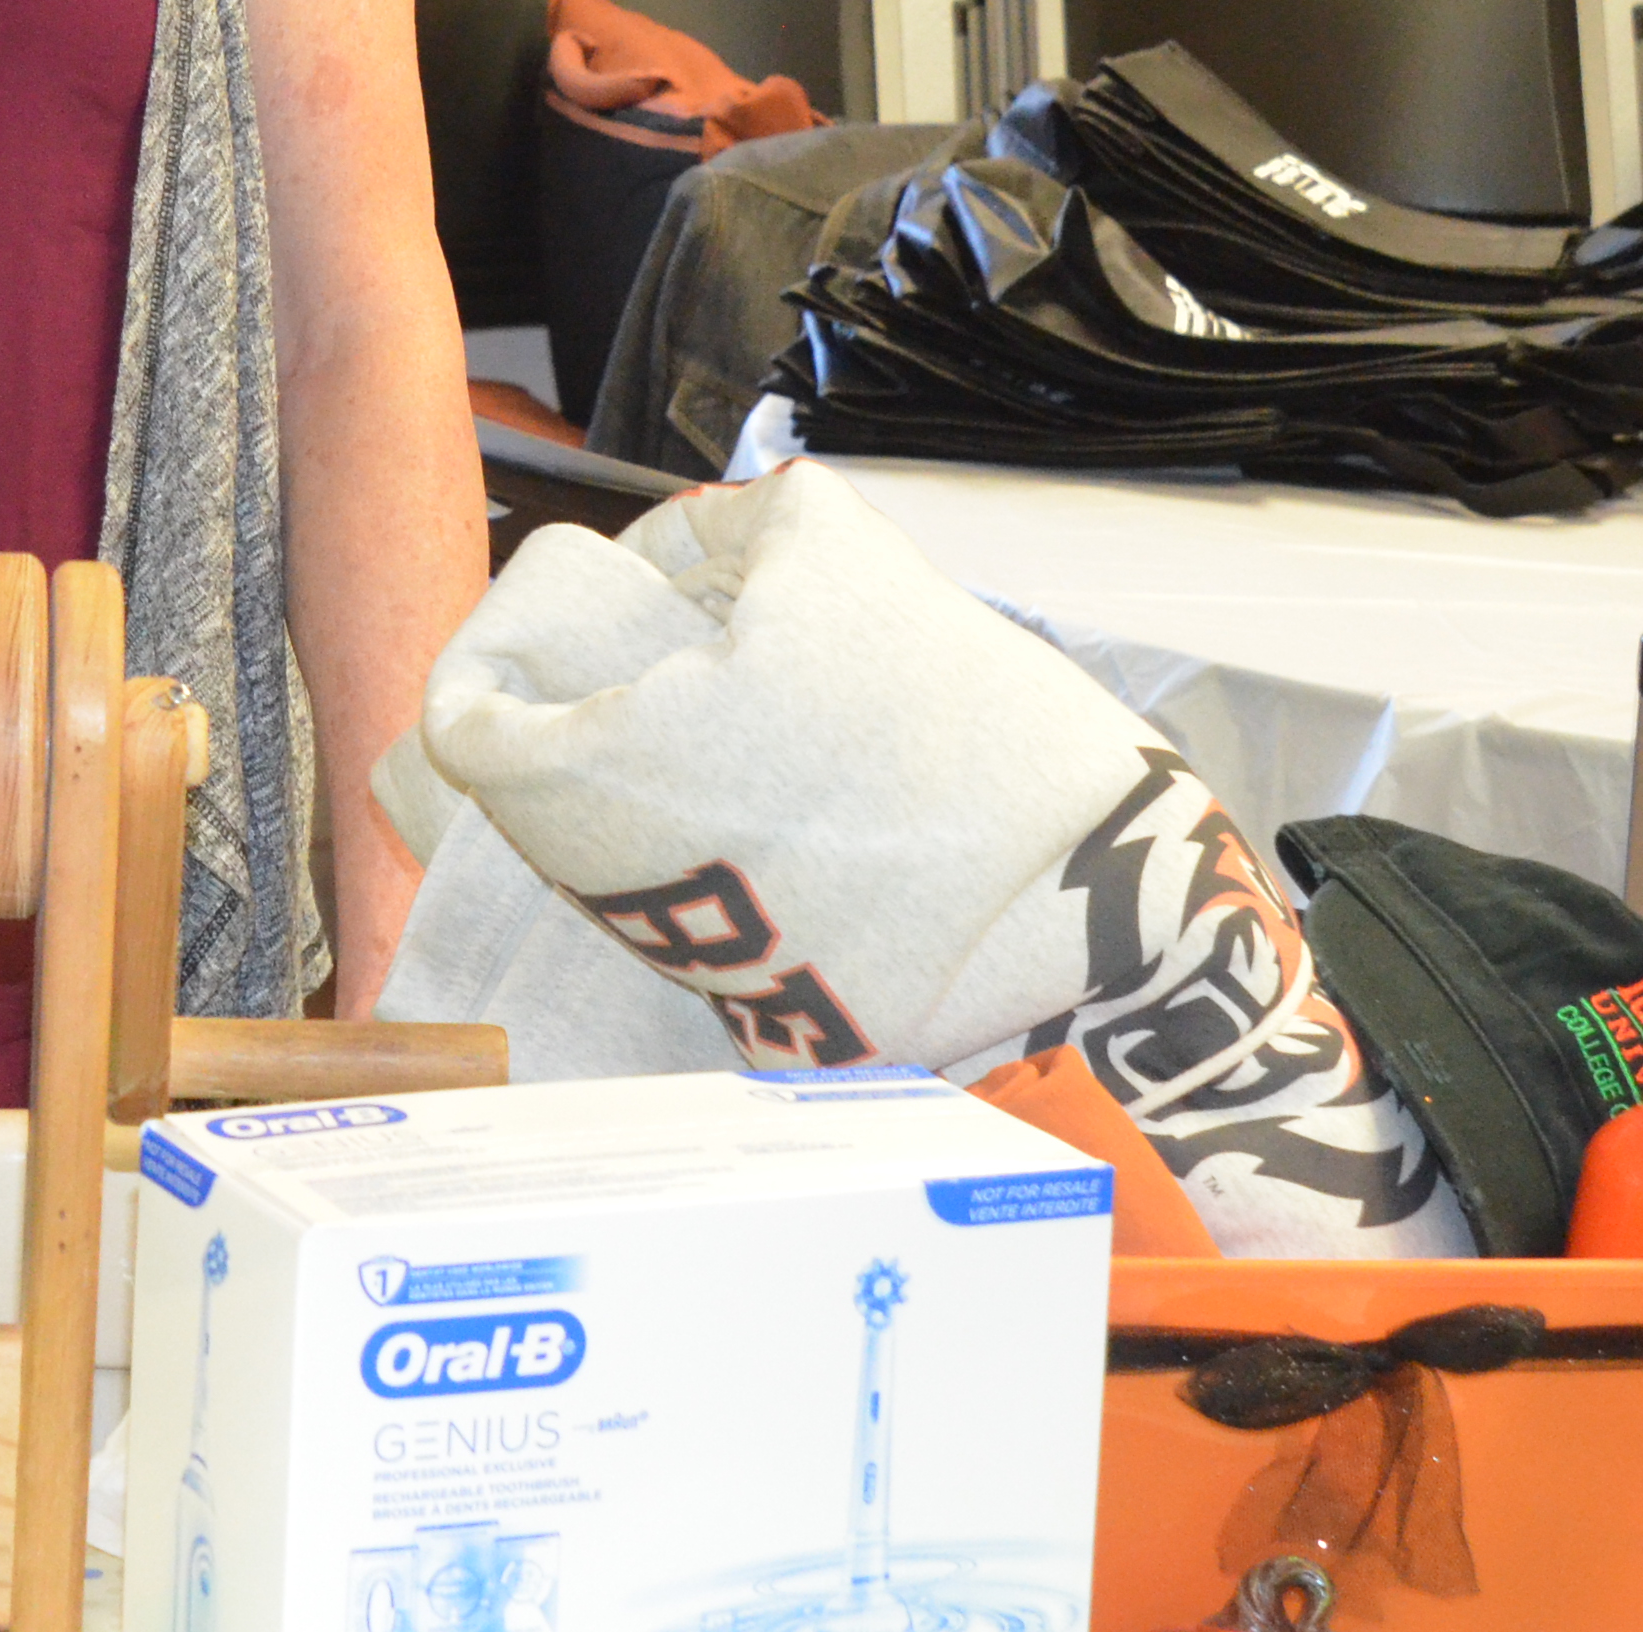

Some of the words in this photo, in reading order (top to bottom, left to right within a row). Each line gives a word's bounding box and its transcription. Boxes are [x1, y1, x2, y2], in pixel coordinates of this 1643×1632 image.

[1556, 1004, 1625, 1101] COLLEGE
[221, 1104, 390, 1138] Oral-B
[971, 1187, 1004, 1203] NOT
[1006, 1184, 1041, 1200] FOR
[1042, 1179, 1102, 1198] RESALE
[968, 1203, 1019, 1222] VENTE
[1020, 1198, 1101, 1217] INTERDITE
[376, 1321, 567, 1389] Oral-B
[373, 1410, 562, 1464] GENIUS
[374, 1465, 479, 1484] PROFESSIONAL
[483, 1457, 557, 1476] EXCLUSIVE
[373, 1485, 484, 1505] RECHARGEABLE
[489, 1476, 581, 1496] TOOTHBRUSH
[373, 1504, 431, 1520] BROSSE
[444, 1500, 491, 1517] DENTS
[493, 1490, 603, 1510] RECHARGEABLE
